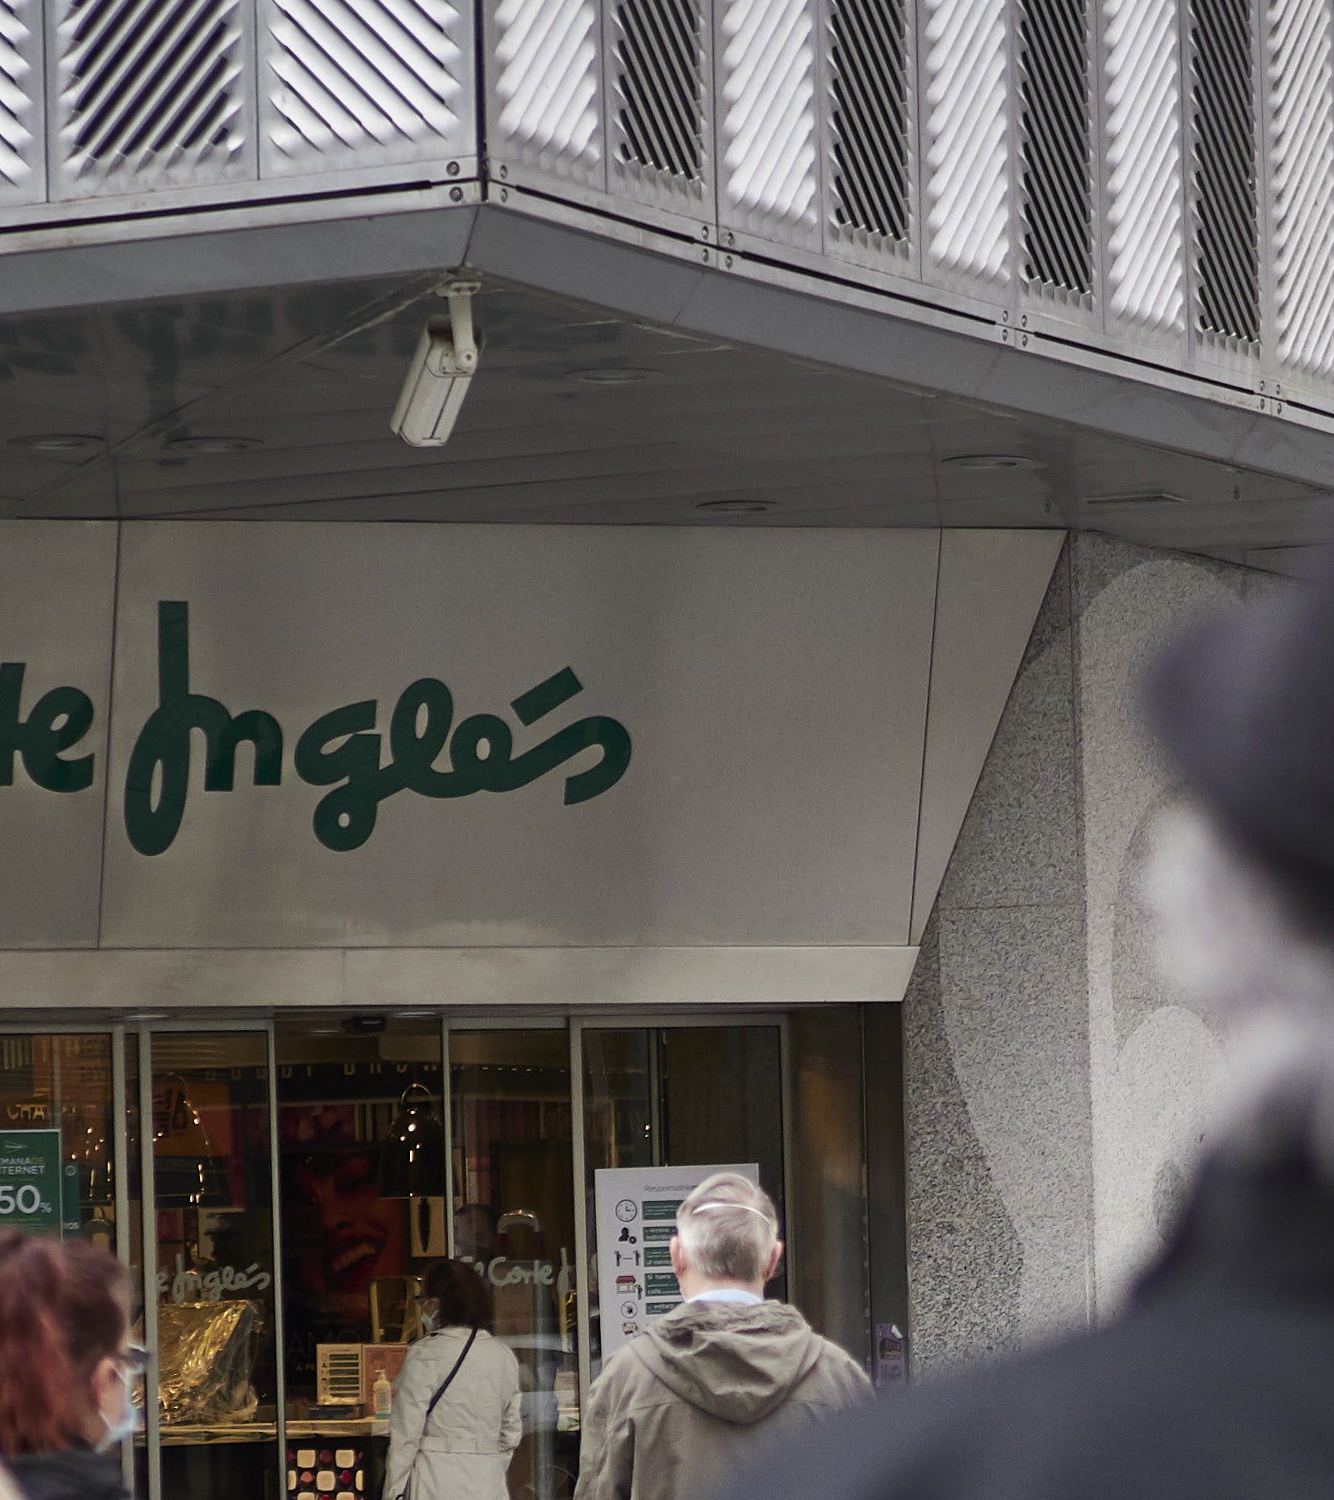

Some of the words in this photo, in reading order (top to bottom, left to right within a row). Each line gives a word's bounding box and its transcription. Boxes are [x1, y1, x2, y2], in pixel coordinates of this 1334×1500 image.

[122, 600, 633, 857] Inglés
[171, 1253, 271, 1304] Inglés
[487, 1256, 554, 1287] Corte
